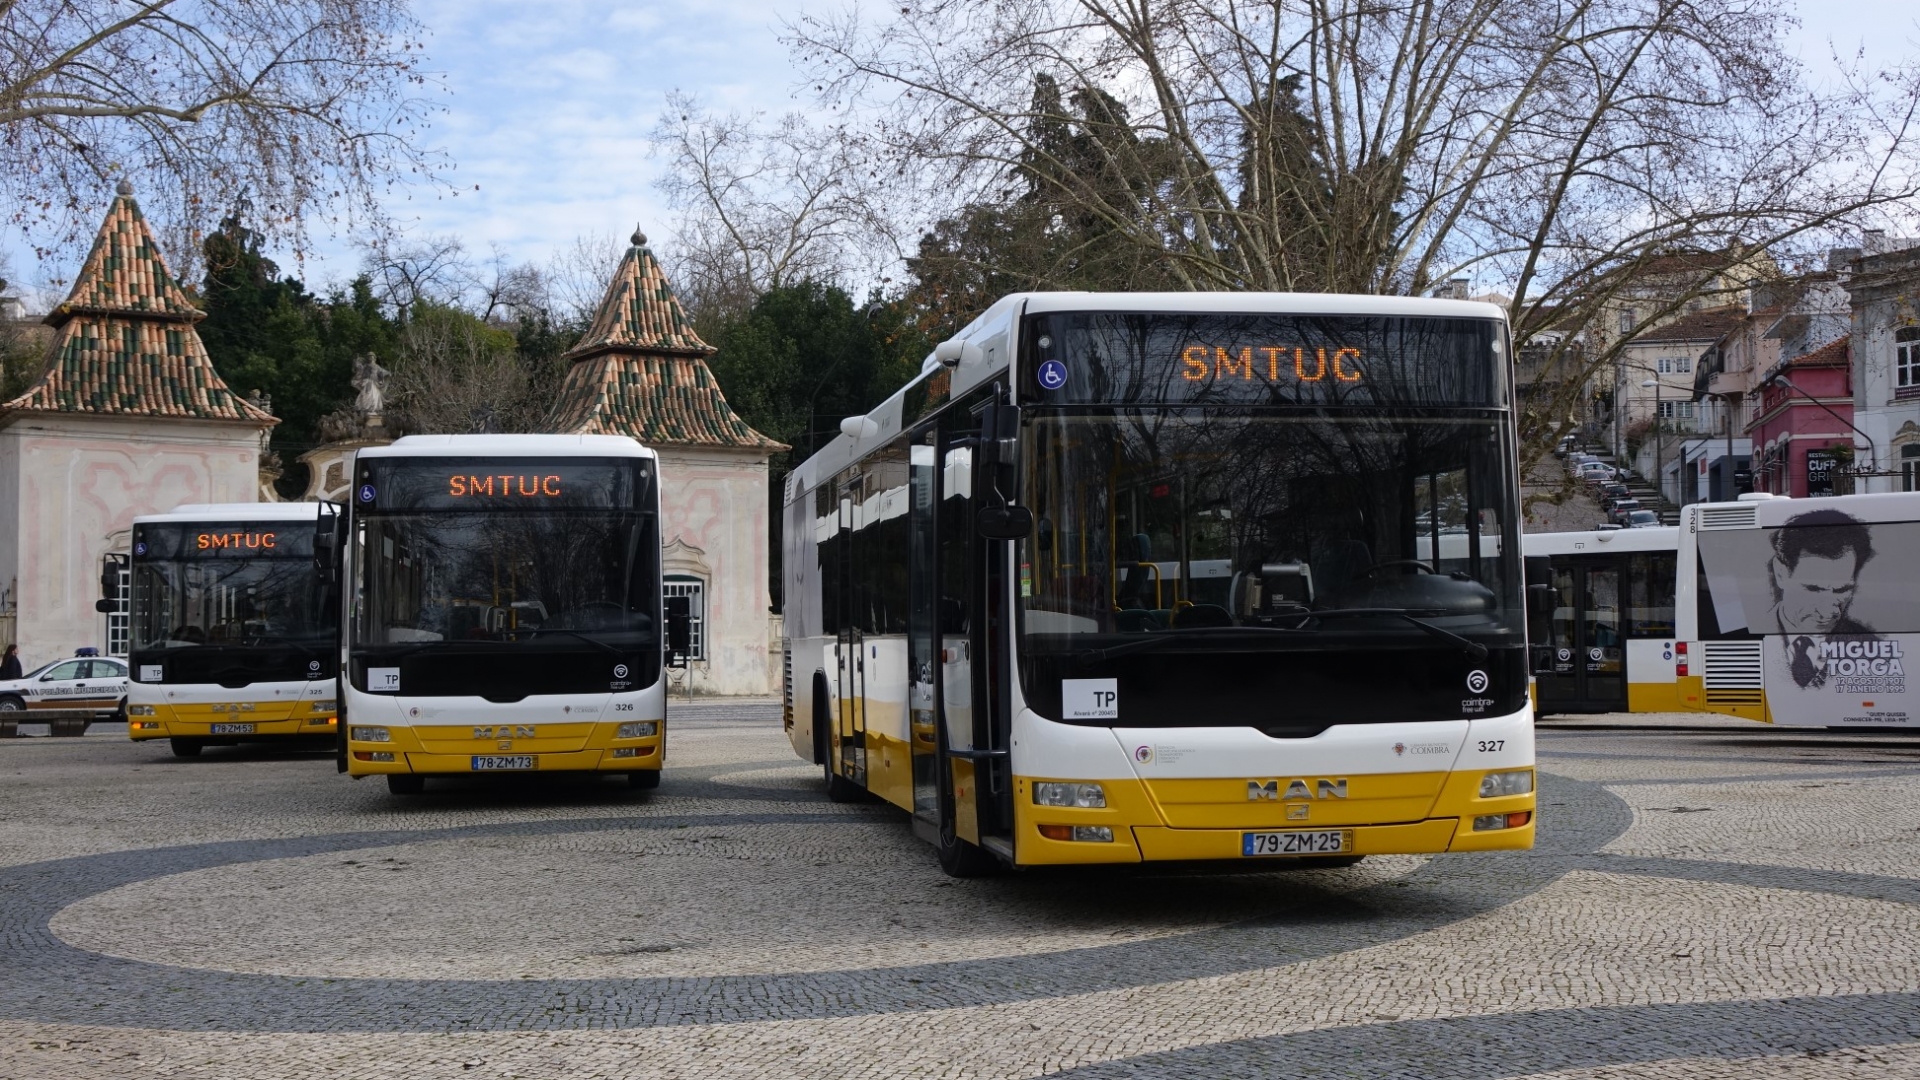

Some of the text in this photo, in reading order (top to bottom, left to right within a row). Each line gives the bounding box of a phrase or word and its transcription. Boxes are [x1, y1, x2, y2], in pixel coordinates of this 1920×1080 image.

[1183, 346, 1360, 380] SMTUC
[450, 475, 560, 496] SMTUC
[198, 532, 275, 549] SMTUC
[1820, 641, 1904, 659] MIGUEL
[152, 669, 162, 677] TP
[1827, 659, 1905, 676] TORGA
[385, 674, 399, 685] TP
[1836, 677, 1905, 685] 12 AGOSTO 1907
[40, 685, 118, 695] POLÍCIA MUNICIPAL
[1835, 685, 1905, 693] 17 JANEIRO 1995
[1093, 691, 1116, 708] TP
[615, 703, 633, 711] 326
[474, 726, 536, 738] MAN
[1410, 746, 1450, 754] COIMBRA
[1478, 740, 1505, 752] 327
[1247, 777, 1348, 800] MAN
